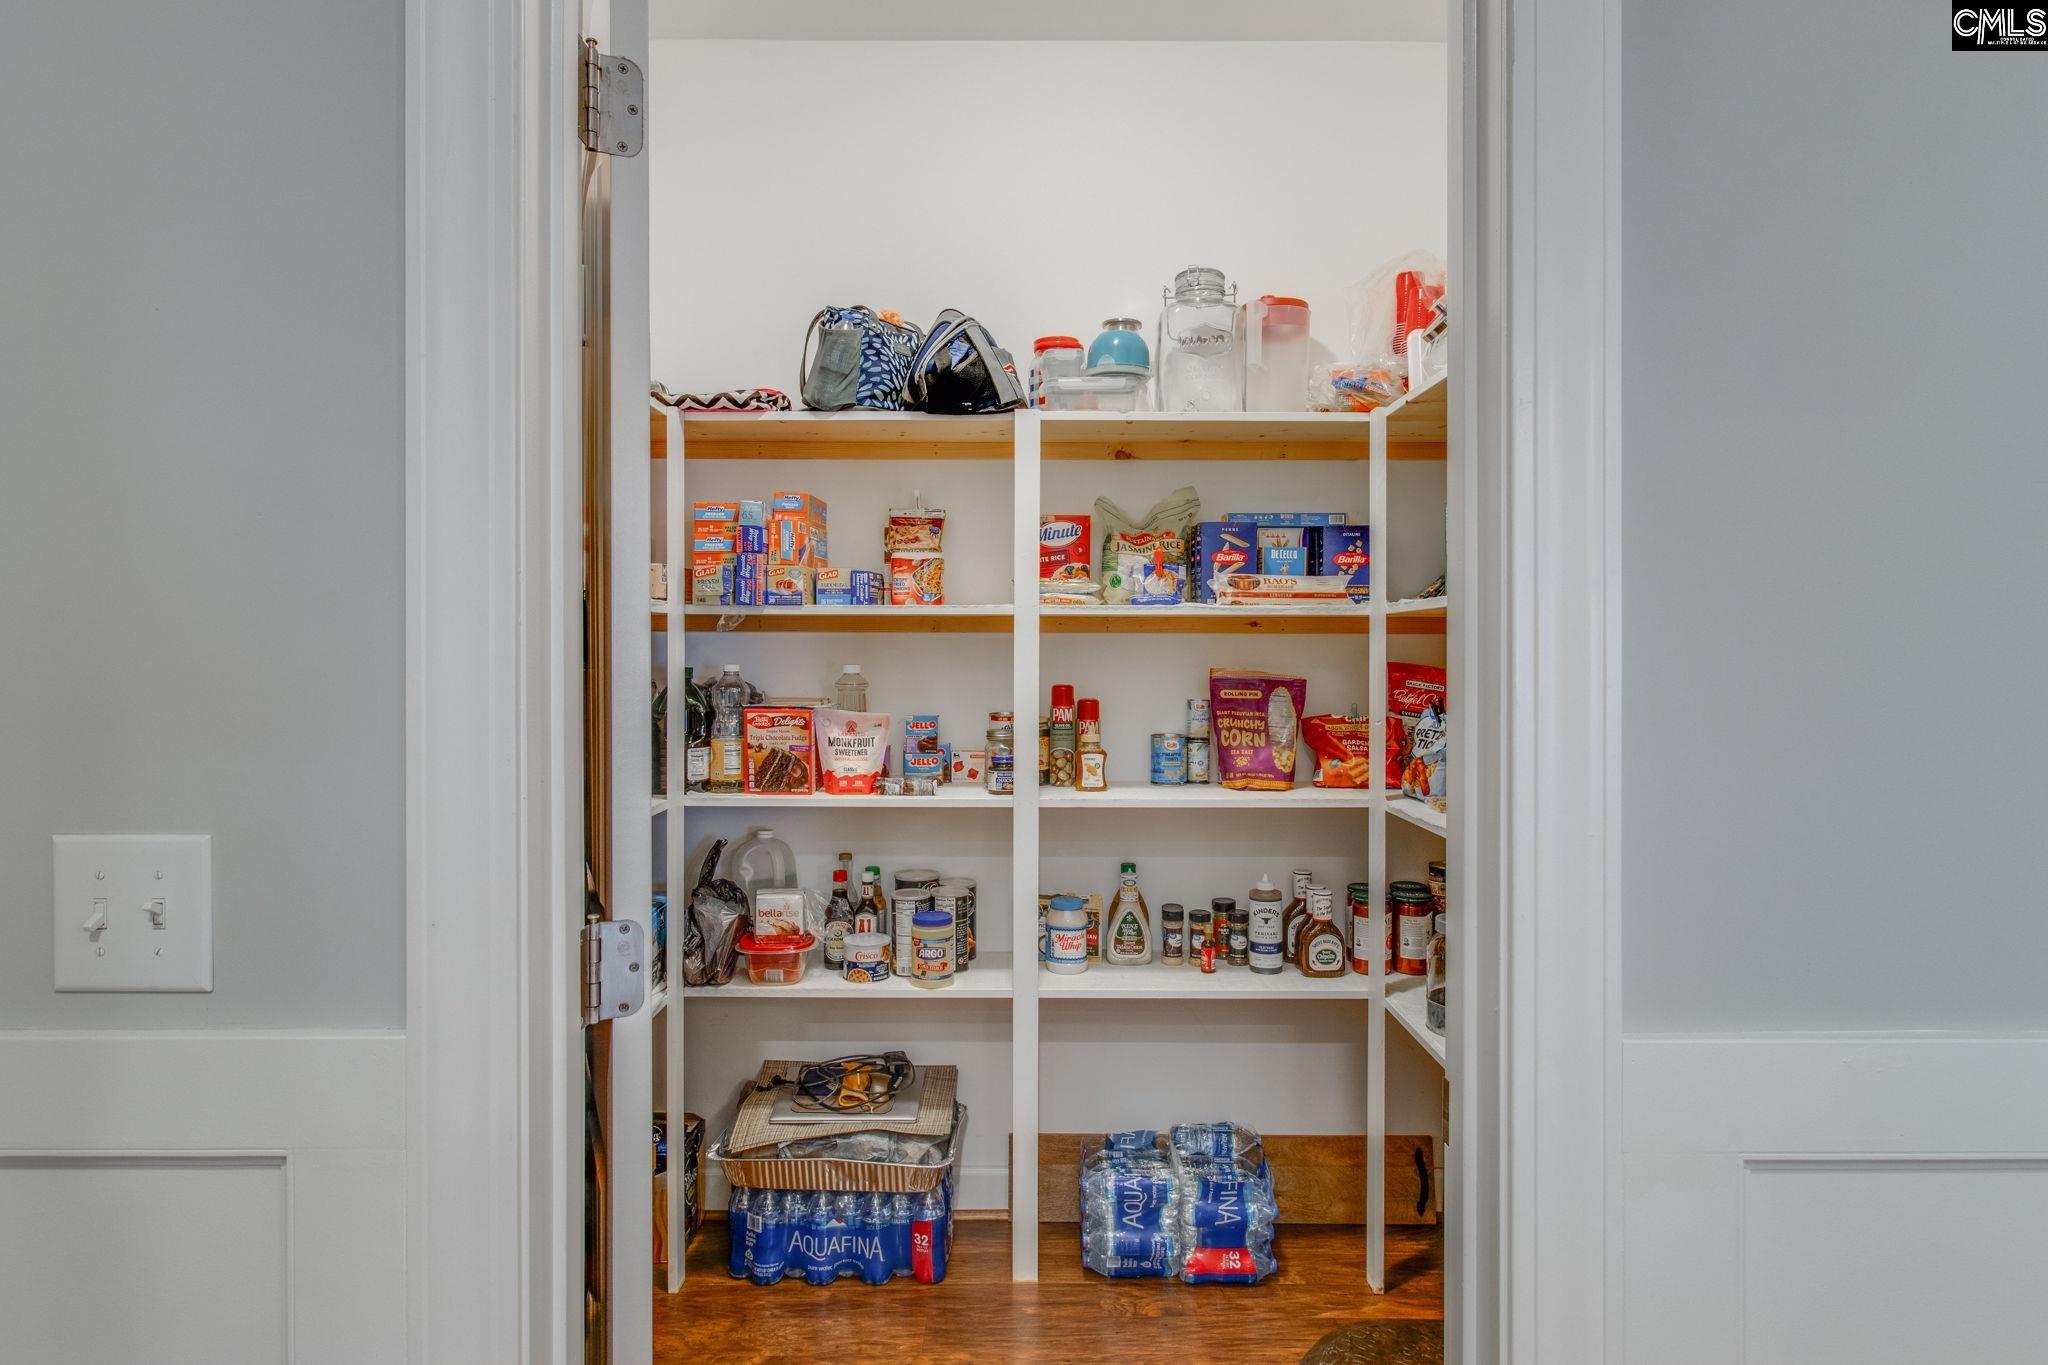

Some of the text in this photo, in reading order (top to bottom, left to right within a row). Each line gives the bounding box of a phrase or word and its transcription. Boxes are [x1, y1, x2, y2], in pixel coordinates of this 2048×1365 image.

[1040, 524, 1082, 542] Minute
[1115, 540, 1182, 554] JASMINE RICE
[1215, 552, 1246, 562] Barilla
[1337, 553, 1366, 563] Barilla
[695, 567, 716, 577] GLAD
[768, 568, 785, 576] GLAD
[818, 570, 838, 579] GLAD
[1263, 577, 1298, 585] RAO'S
[1406, 680, 1444, 691] SNACK FACTORY
[1052, 708, 1073, 722] PAM
[773, 716, 806, 728] Delights
[1217, 718, 1265, 730] CRUNCHY
[1079, 721, 1099, 735] PAM
[827, 736, 876, 748] MONKFRUIT
[1220, 728, 1266, 747] CORN
[834, 748, 868, 757] SWEETENER
[758, 908, 800, 918] bellarise
[1059, 941, 1083, 951] Whip
[855, 951, 879, 961] Crisco
[918, 949, 944, 958] ARGO
[914, 1232, 929, 1246] 32
[788, 1230, 885, 1262] AQUAFINA
[1228, 1250, 1241, 1269] 32
